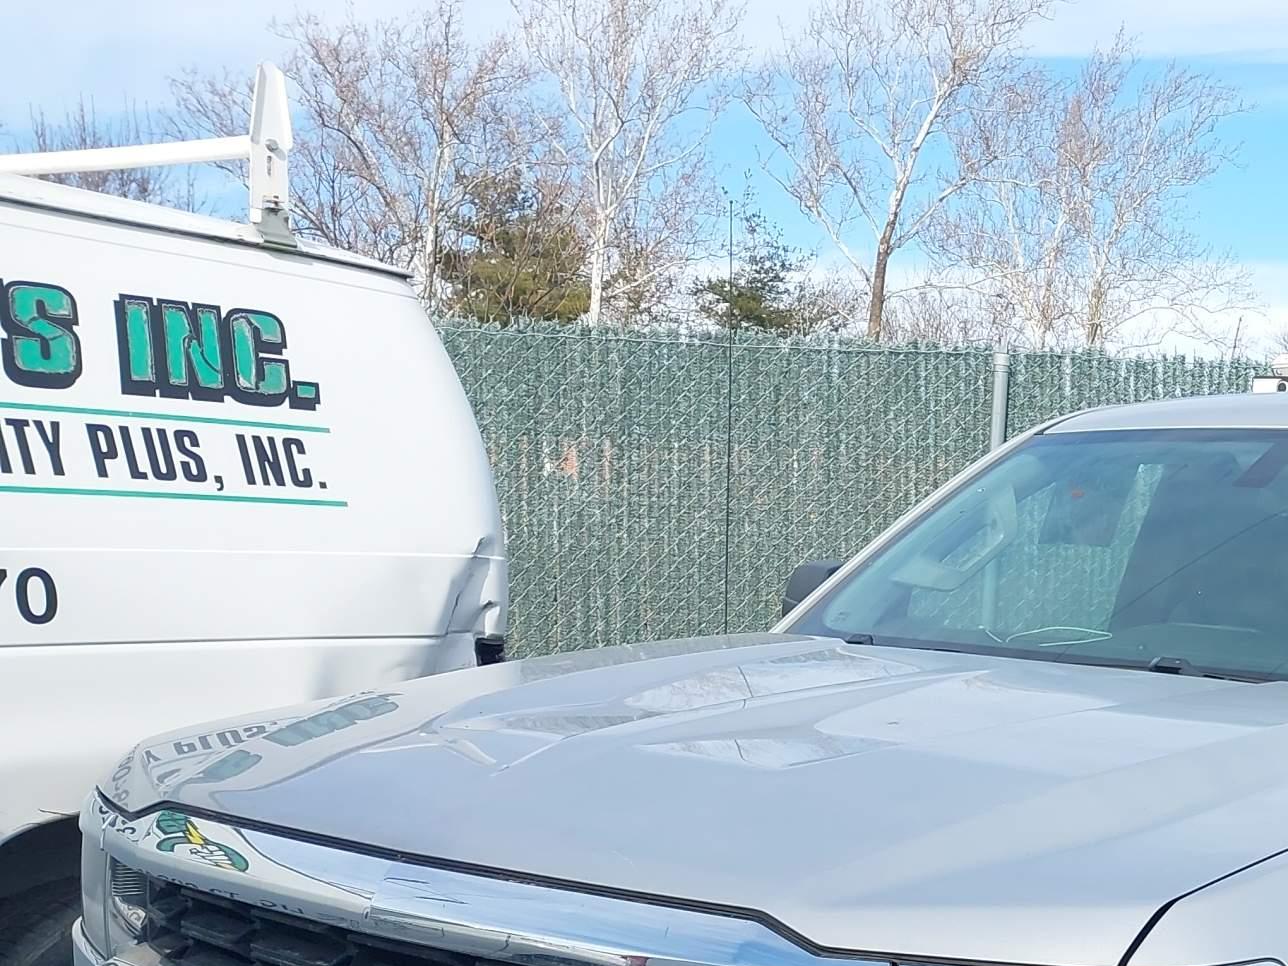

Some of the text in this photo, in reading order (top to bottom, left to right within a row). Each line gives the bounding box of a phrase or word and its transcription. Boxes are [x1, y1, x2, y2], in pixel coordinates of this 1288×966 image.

[0, 278, 320, 411] S INC.
[86, 423, 225, 491] PLUS,
[235, 434, 328, 489] INC.
